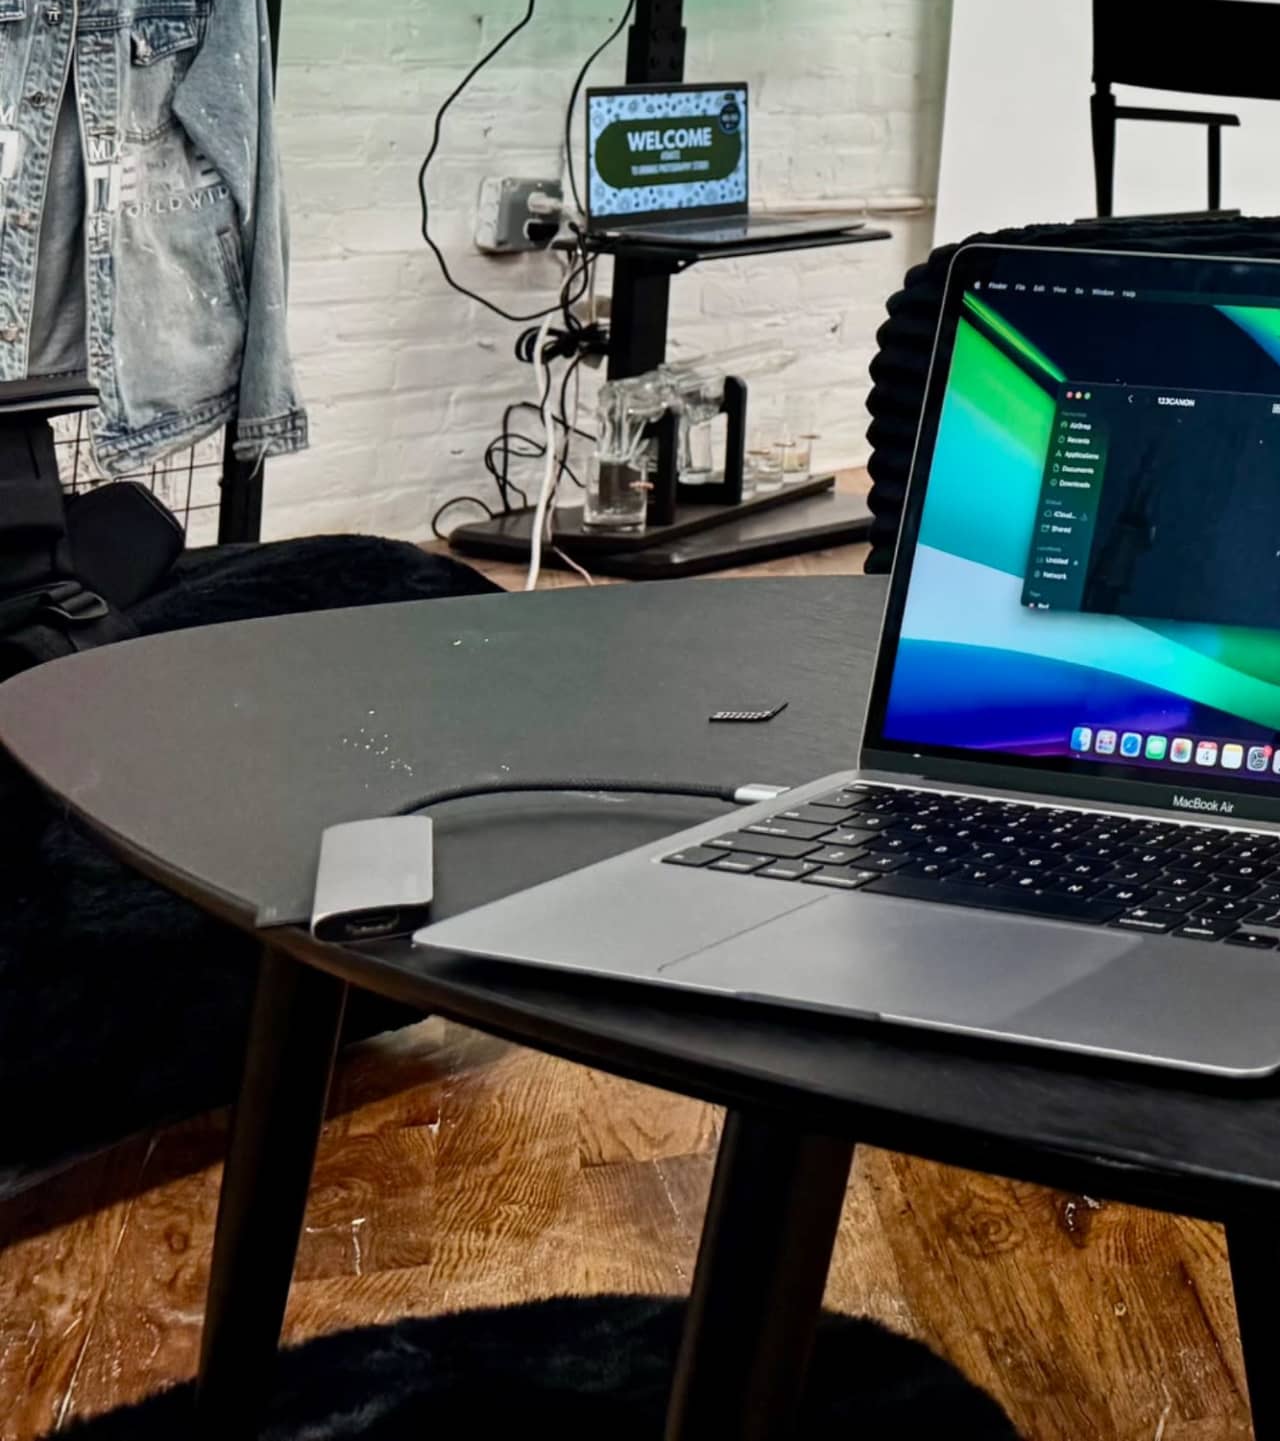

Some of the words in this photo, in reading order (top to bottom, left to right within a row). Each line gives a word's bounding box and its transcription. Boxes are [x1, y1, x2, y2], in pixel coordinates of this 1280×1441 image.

[627, 127, 713, 152] WELCOME
[1172, 795, 1219, 811] MacBook
[1219, 801, 1235, 814] Air
